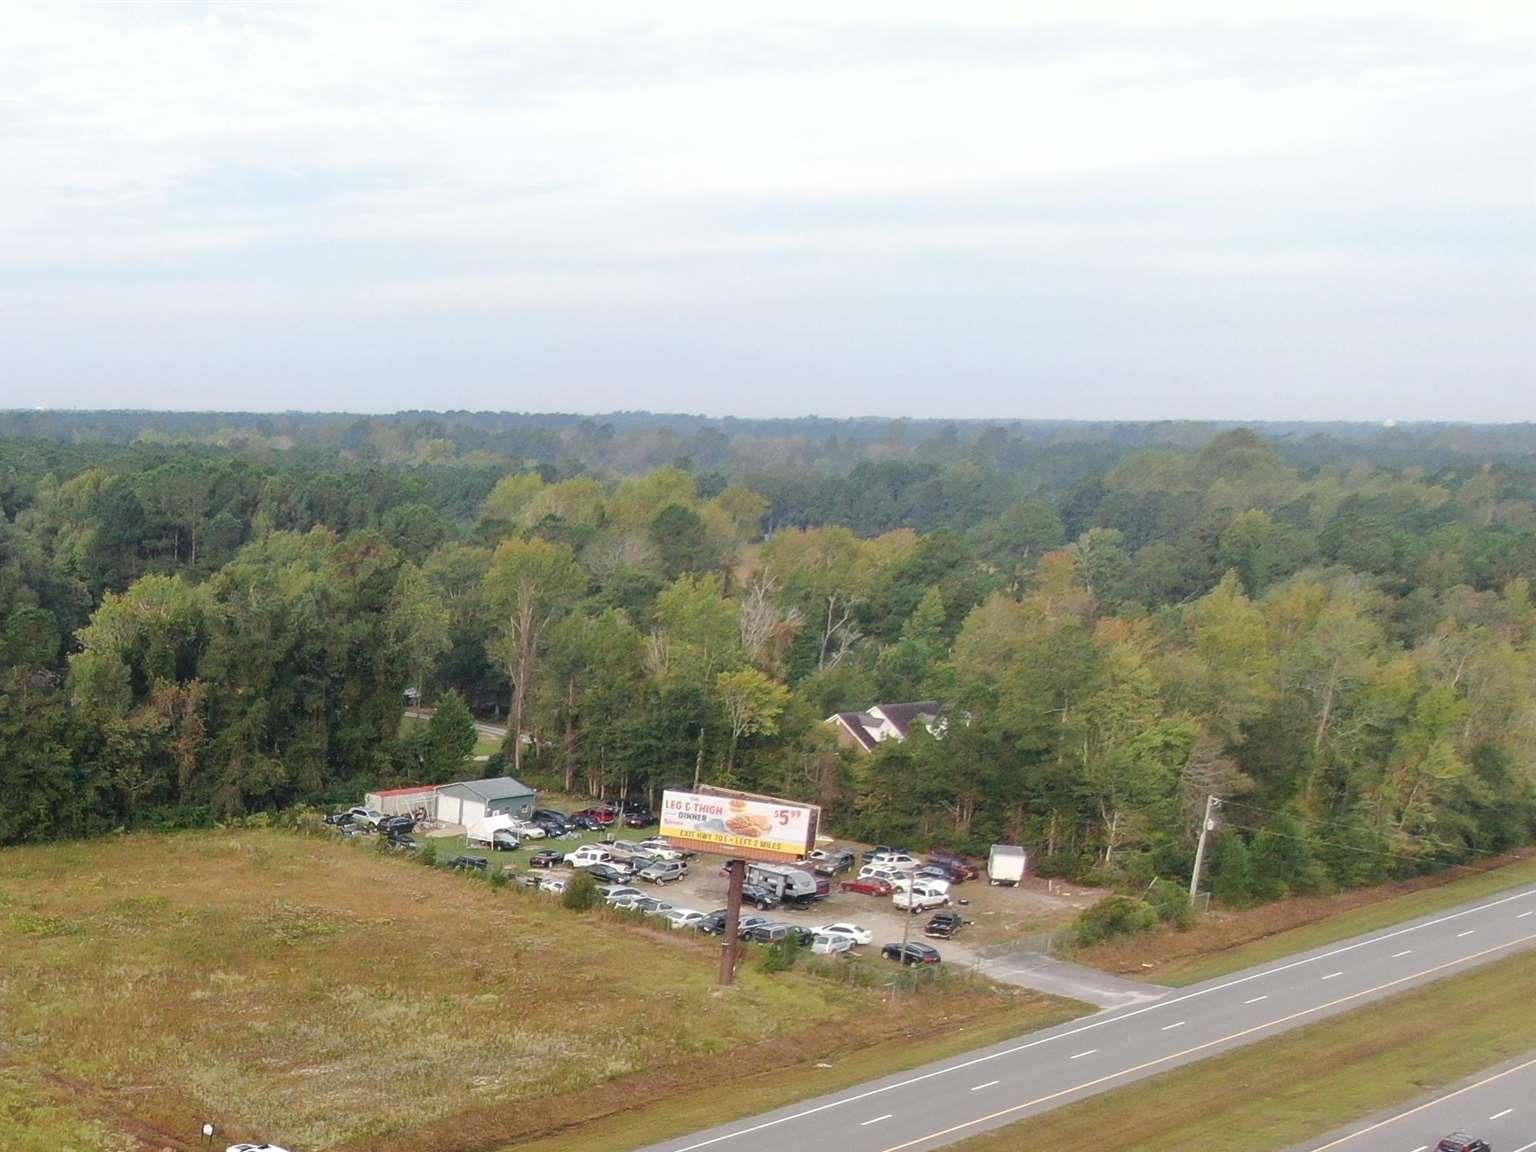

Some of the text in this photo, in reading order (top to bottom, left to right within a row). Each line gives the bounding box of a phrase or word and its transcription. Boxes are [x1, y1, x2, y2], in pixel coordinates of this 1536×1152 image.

[665, 800, 682, 809] LEG
[694, 804, 723, 815] THIGH
[678, 811, 707, 821] DINNER
